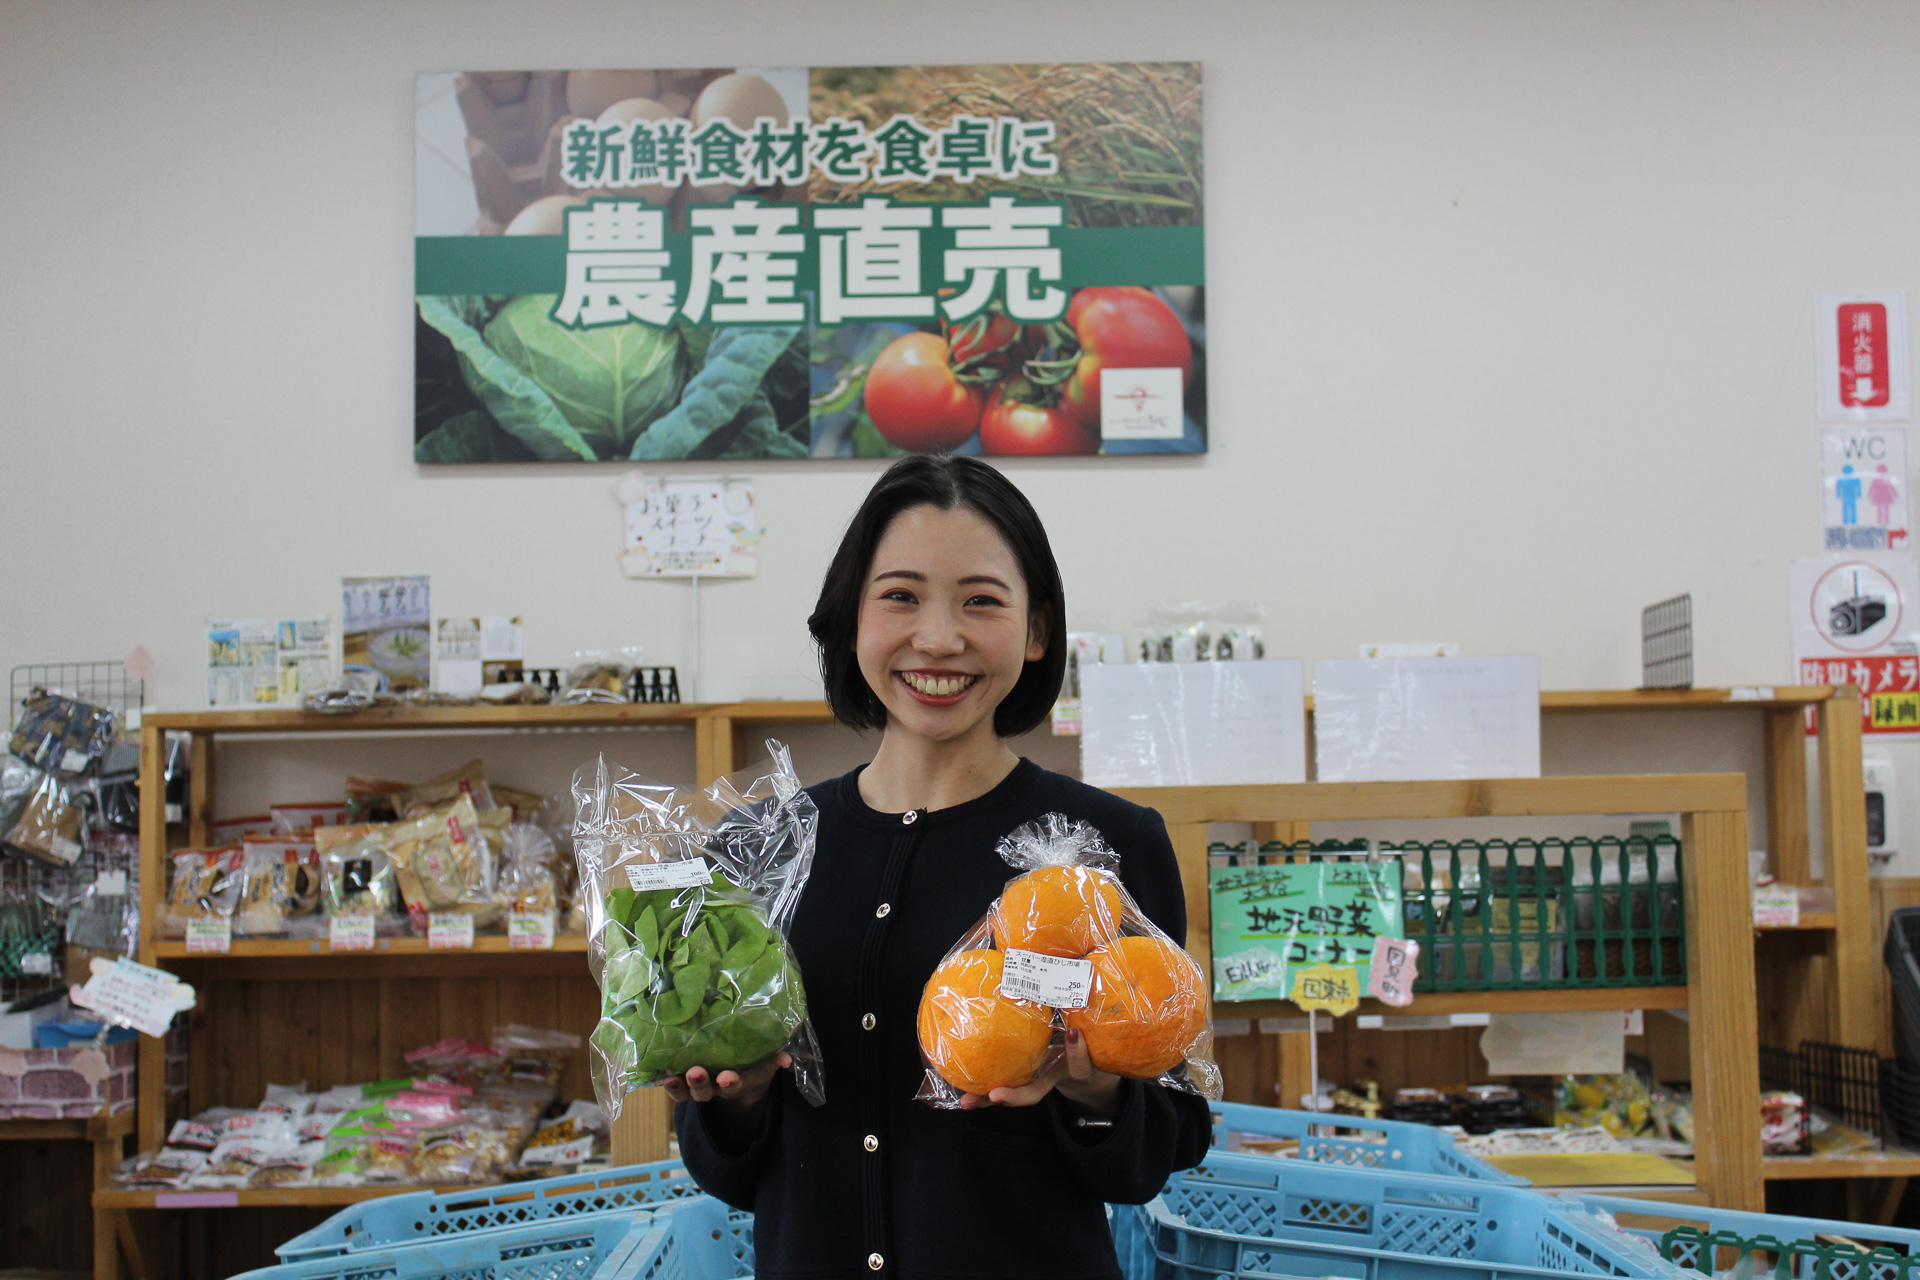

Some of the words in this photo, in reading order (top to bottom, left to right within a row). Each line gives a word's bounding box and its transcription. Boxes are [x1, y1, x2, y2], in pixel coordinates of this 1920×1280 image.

[565, 118, 1054, 183] 新鮮食材を食卓に
[556, 199, 1067, 325] 農産直売
[1852, 312, 1874, 375] 消火器
[1842, 436, 1886, 460] WC
[1802, 659, 1919, 692] 防犯カメラ
[1875, 697, 1918, 724] 録画
[1246, 900, 1376, 937] 地元野菜
[1288, 939, 1371, 963] コーナー
